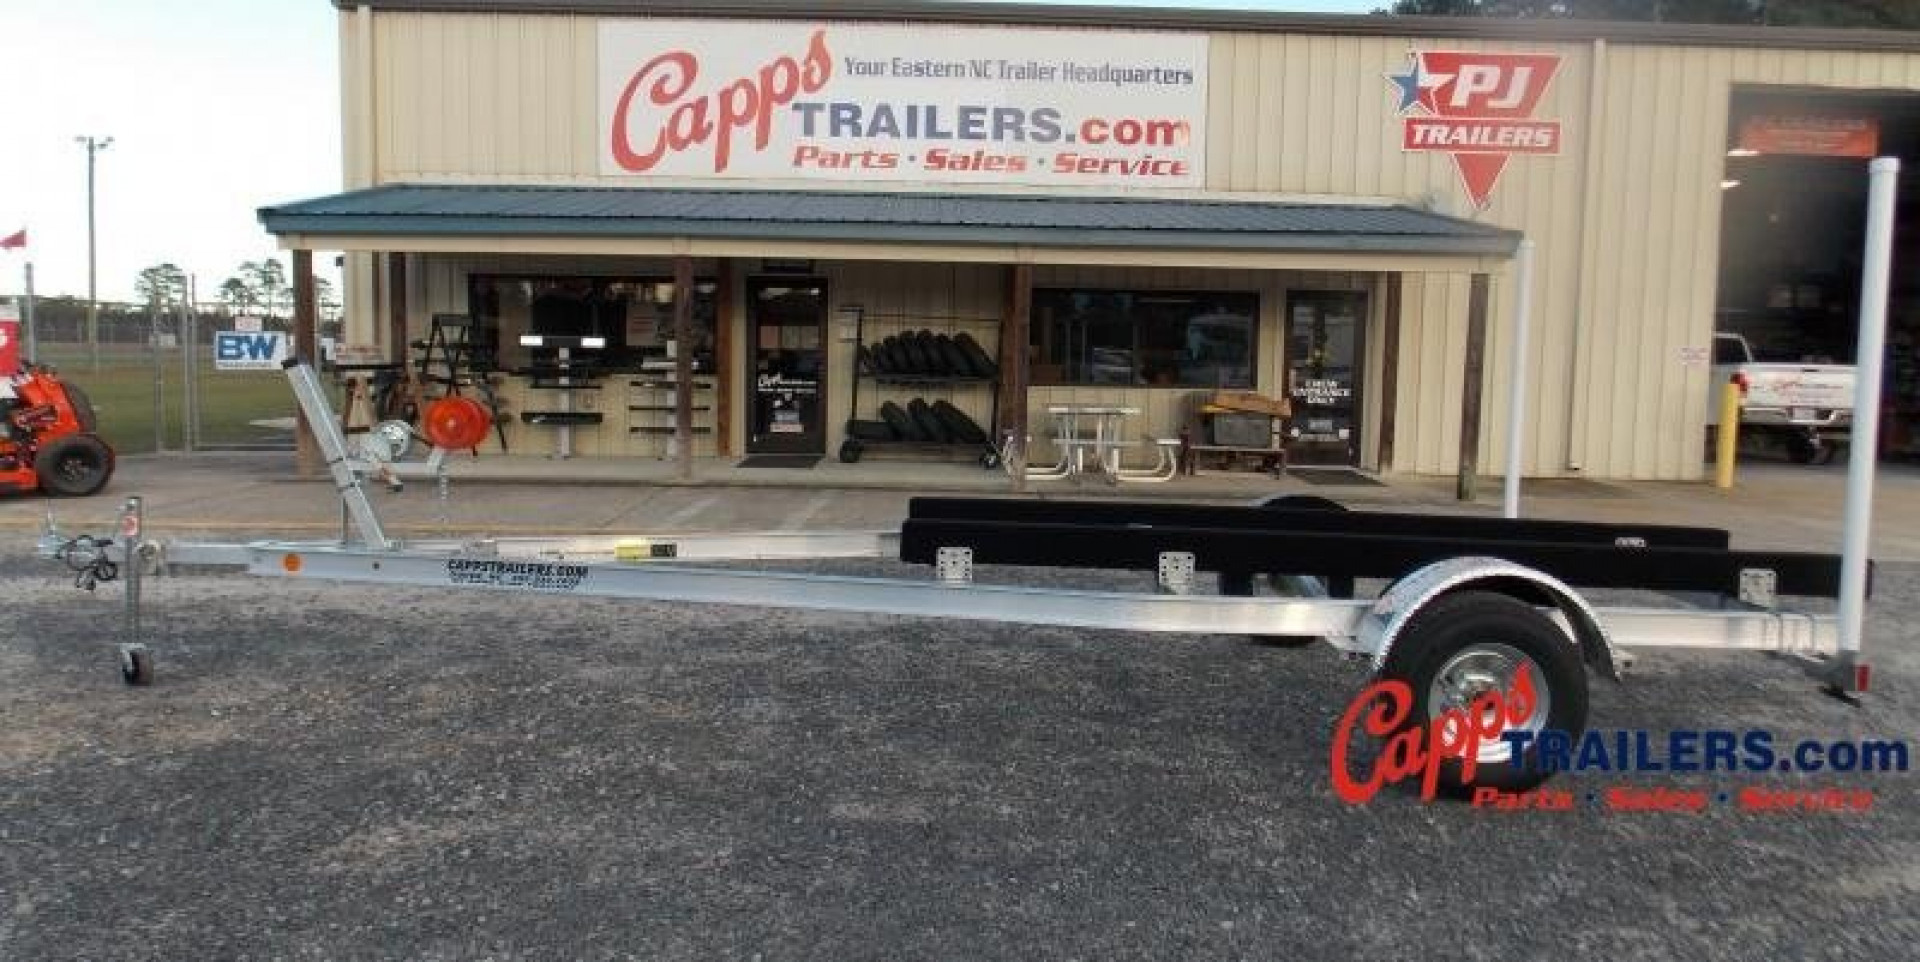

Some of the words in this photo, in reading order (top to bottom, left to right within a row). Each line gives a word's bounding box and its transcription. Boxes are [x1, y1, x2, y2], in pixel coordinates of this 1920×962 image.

[844, 57, 888, 78] Your
[892, 58, 965, 79] Eastern
[968, 59, 993, 80] NC
[998, 60, 1057, 82] Trailer
[1062, 62, 1194, 86] Headquarters
[1450, 64, 1534, 109] PJ
[610, 28, 833, 173] Capps
[791, 103, 1191, 147] TRAILERS.com
[1412, 124, 1554, 147] TRAILERS
[793, 147, 900, 169] Parts
[923, 149, 1026, 173] Sales
[1053, 153, 1190, 176] Service
